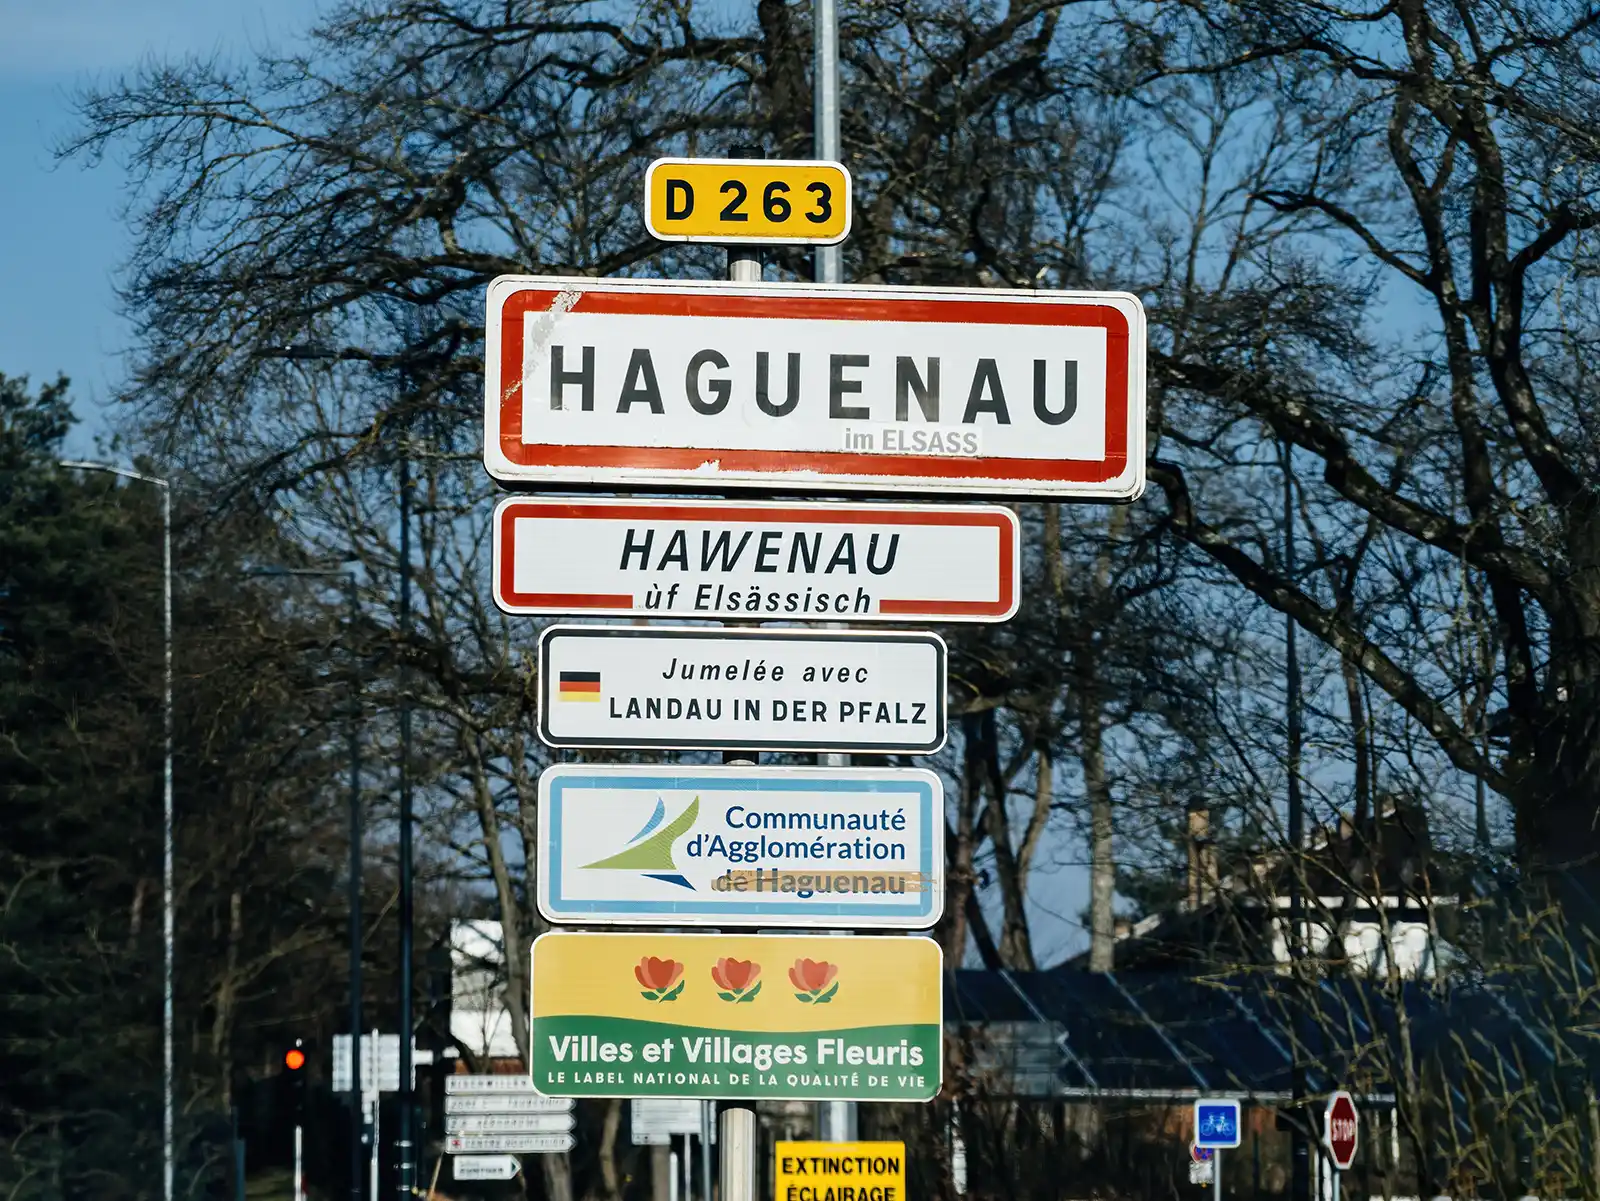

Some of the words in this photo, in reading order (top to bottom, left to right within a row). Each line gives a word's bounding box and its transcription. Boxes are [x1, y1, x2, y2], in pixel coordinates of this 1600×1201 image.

[666, 179, 694, 220] D
[720, 180, 831, 223] 263
[551, 346, 1077, 425] HAGUENAU
[845, 428, 874, 451] im
[882, 430, 979, 455] ELSASS
[620, 529, 899, 575] HAWENAU
[645, 584, 679, 609] ùf
[695, 584, 870, 613] Elsässisch
[663, 658, 783, 681] Jumelée
[803, 667, 867, 683] avec
[610, 697, 721, 720] LANDAU
[734, 699, 760, 721] IN
[773, 700, 826, 722] DER
[840, 702, 926, 724] PFALZ
[726, 806, 905, 830] Communauté
[687, 834, 904, 862] d'Agglomération
[716, 868, 748, 893] de
[757, 868, 905, 898] Haguenau
[549, 1036, 633, 1062] Villes
[643, 1039, 674, 1062] et
[682, 1037, 807, 1071] Villages
[818, 1039, 923, 1065] Fleuris
[549, 1072, 564, 1083] LE
[575, 1072, 624, 1083] LABEL
[634, 1073, 720, 1084] NATIONAL
[730, 1074, 749, 1085] DE
[760, 1075, 777, 1085] LA
[787, 1072, 858, 1087] QUALITÉ
[869, 1076, 888, 1086] DE
[898, 1076, 924, 1087] VIE
[1332, 1119, 1355, 1141] STOP
[783, 1157, 899, 1174] EXTINCTION
[787, 1182, 895, 1201] ÉCLAIRAGE
